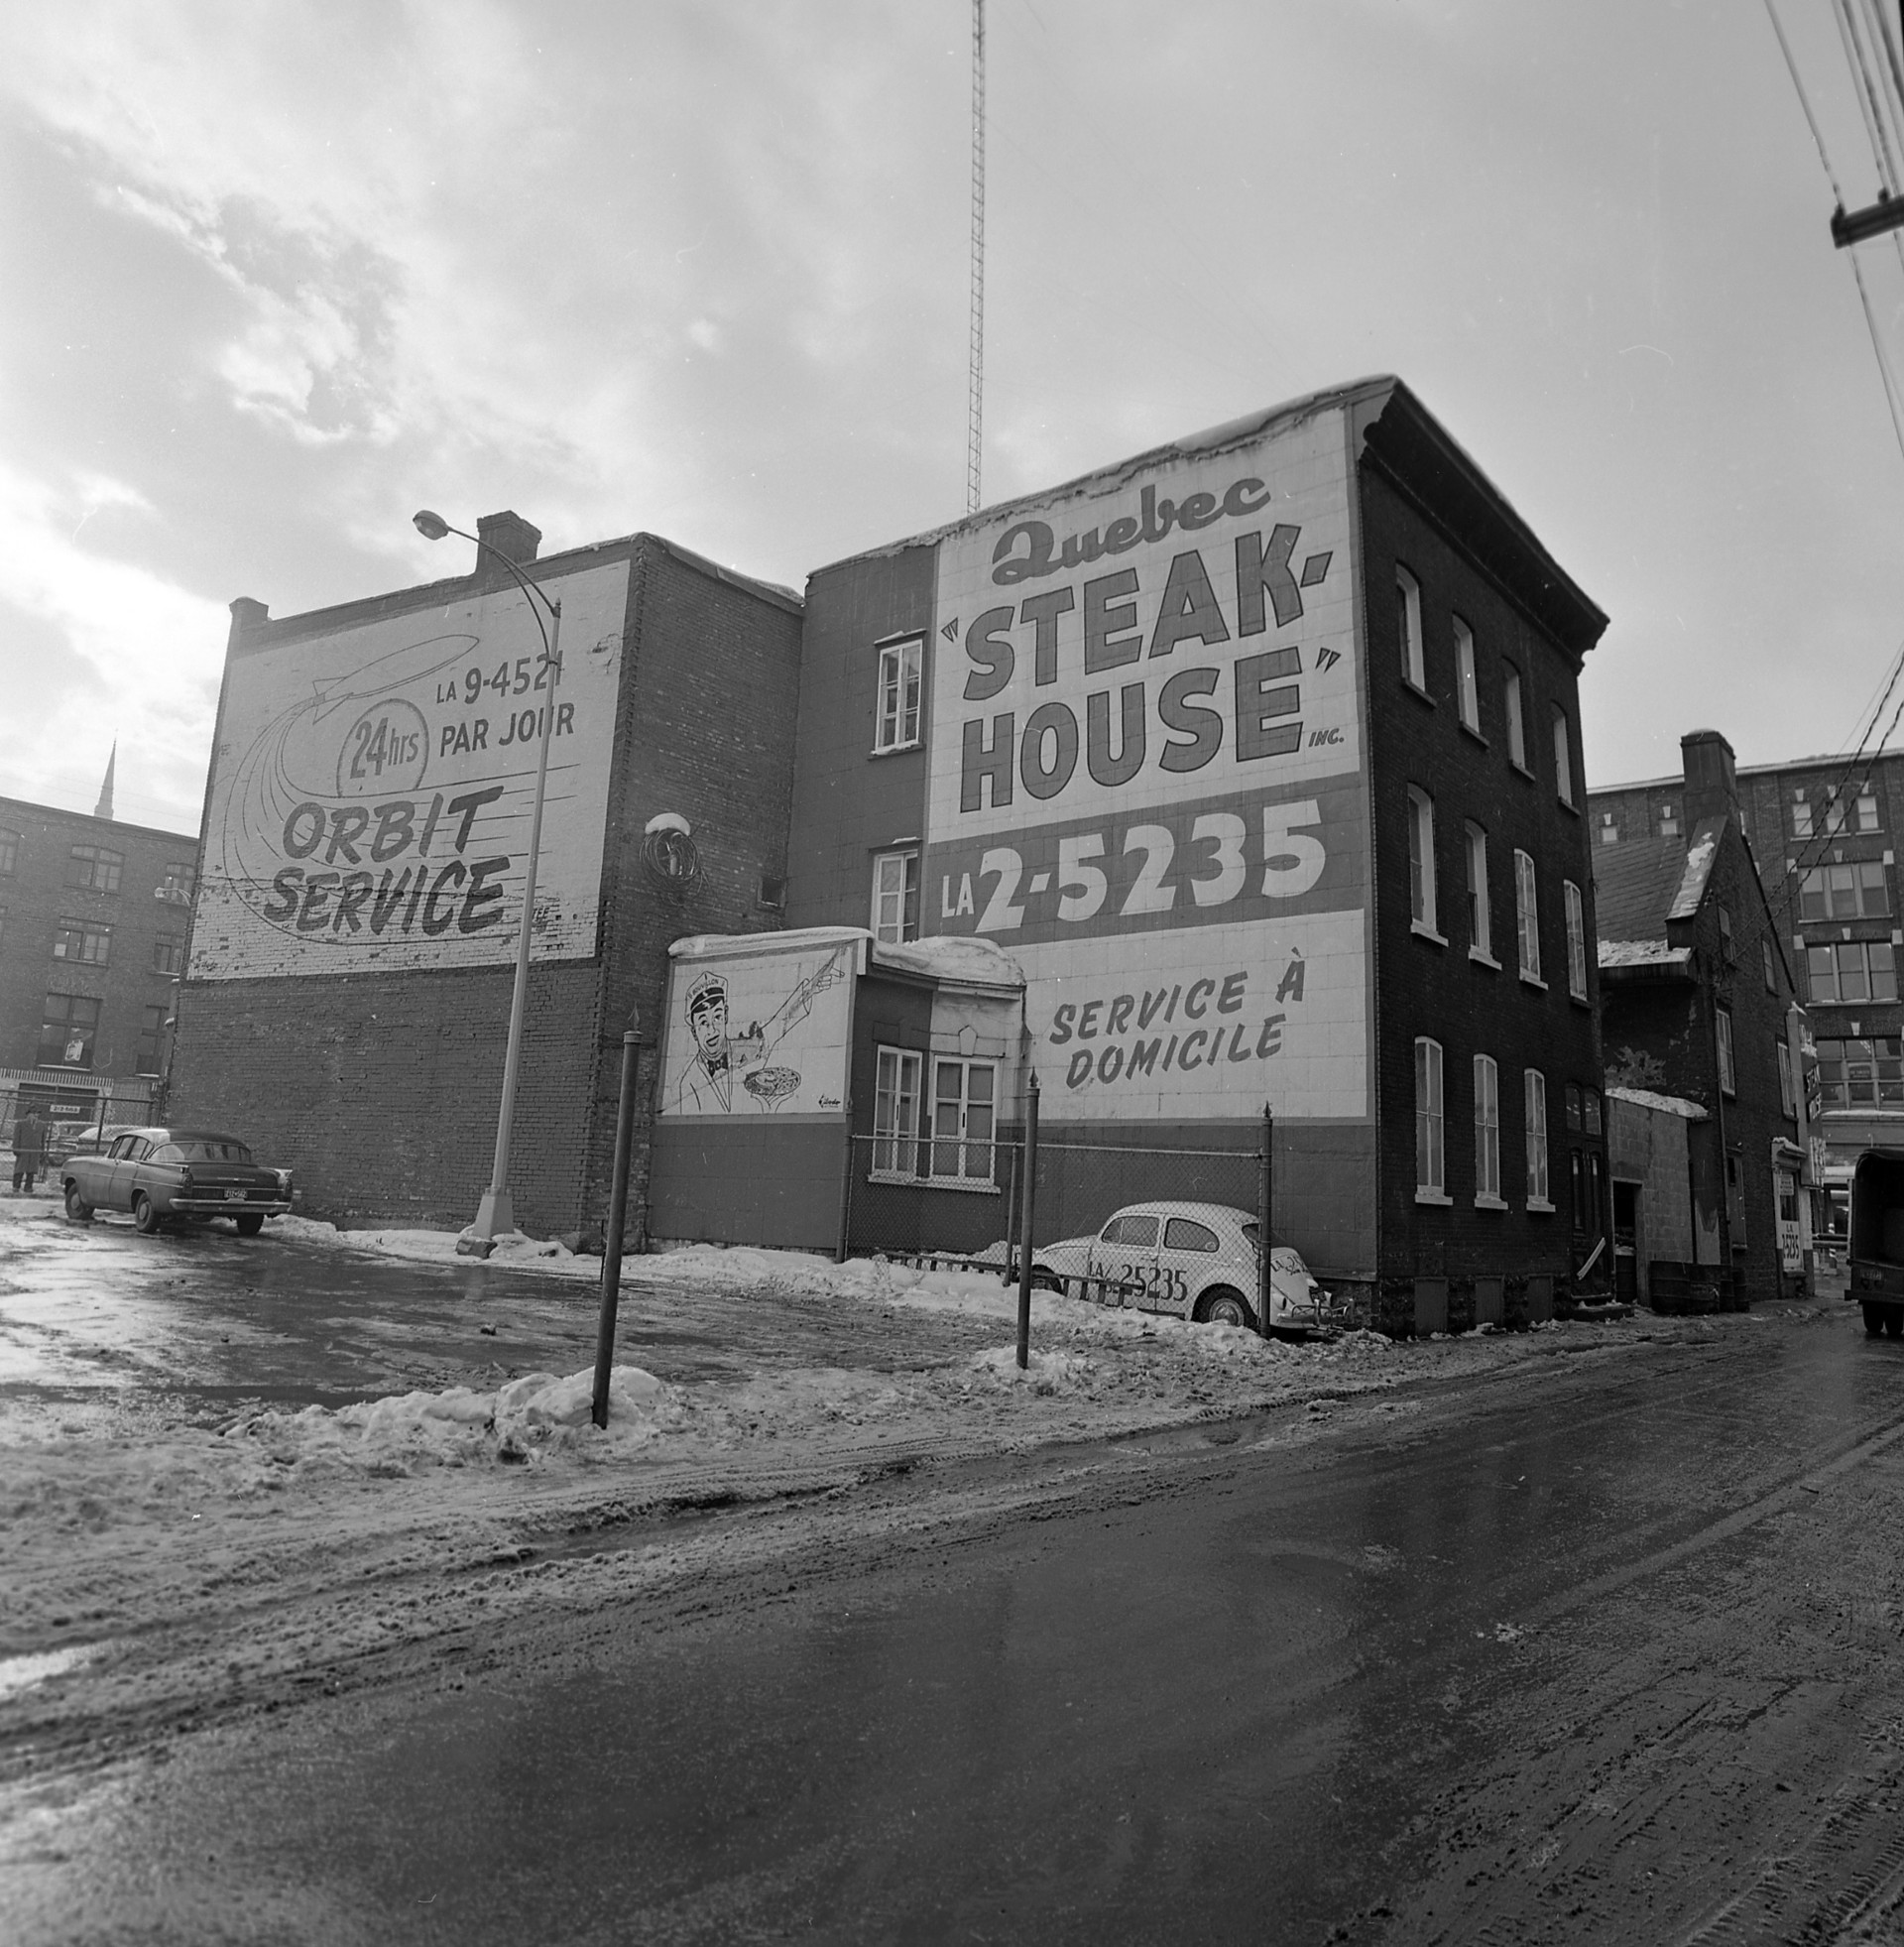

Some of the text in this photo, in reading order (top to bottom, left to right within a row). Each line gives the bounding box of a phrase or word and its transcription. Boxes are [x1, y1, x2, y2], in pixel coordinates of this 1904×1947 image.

[992, 477, 1271, 586] Quebec
[436, 650, 564, 704] LA 9-4521
[350, 717, 419, 781] 24hrs
[439, 702, 575, 758] PAR JOUR
[1308, 728, 1345, 748] INC.
[282, 786, 505, 866] ORBIT
[263, 857, 511, 936] SERVICE
[942, 798, 1326, 933] LA 2-5235
[1048, 946, 1307, 1045] SERVICE À
[1065, 1013, 1287, 1090] DOMICILE
[1122, 1264, 1188, 1301] 25235
